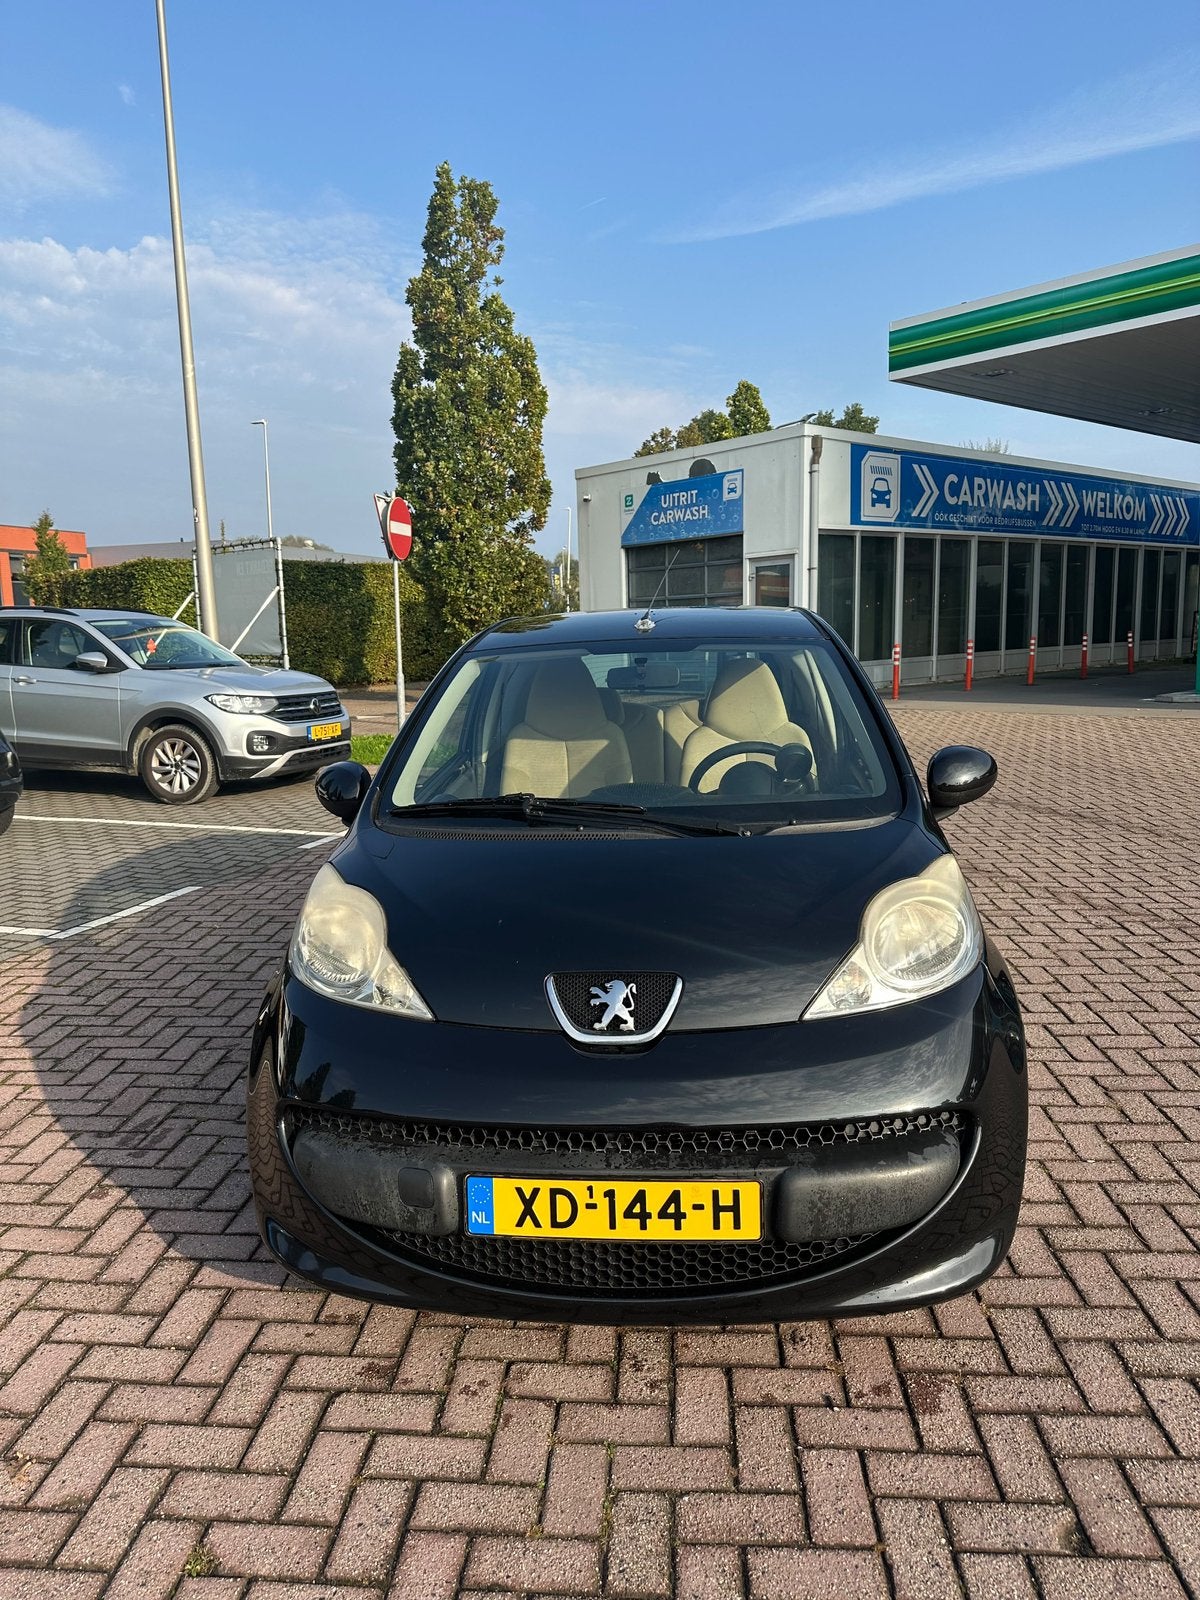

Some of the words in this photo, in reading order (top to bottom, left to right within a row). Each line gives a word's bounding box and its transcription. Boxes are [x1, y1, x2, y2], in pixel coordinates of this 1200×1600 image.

[661, 490, 698, 508] UITRIT
[944, 474, 1039, 512] CARWASH
[1082, 489, 1146, 522] WELKOM
[651, 504, 708, 525] CARWASH
[949, 513, 977, 523] GESCHIKT
[994, 516, 1037, 527] BEDRIJFSBUSSEN
[471, 1210, 491, 1225] NL
